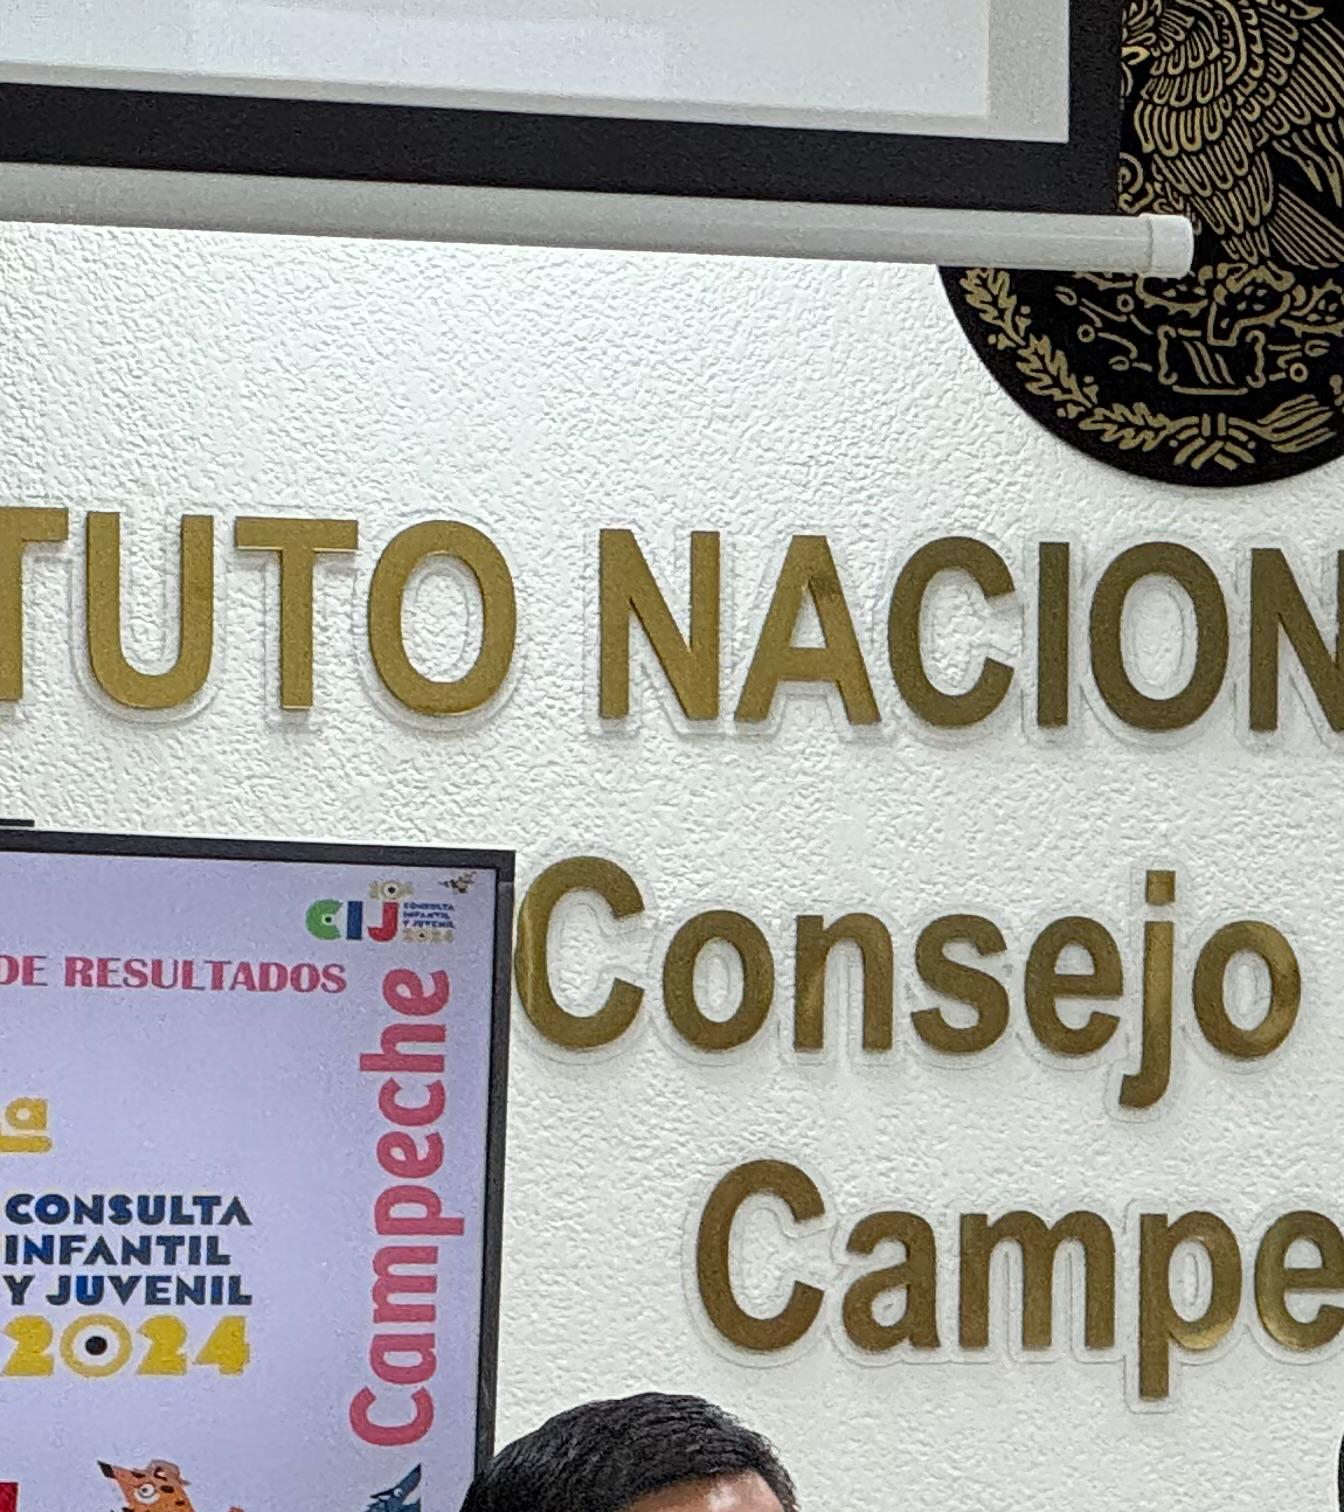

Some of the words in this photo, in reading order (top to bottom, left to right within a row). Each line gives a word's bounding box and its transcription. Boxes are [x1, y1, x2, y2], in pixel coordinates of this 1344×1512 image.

[306, 899, 399, 943] CIJ
[0, 955, 48, 987] DE
[64, 956, 347, 993] RESULTADOS
[514, 855, 1302, 1109] Consejo
[5, 1193, 252, 1225] CONSULTA
[350, 968, 465, 1447] Campeche
[4, 1235, 231, 1266] INFANTIL
[3, 1275, 35, 1306] Y
[46, 1275, 252, 1306] JUVENIL
[1, 1313, 250, 1378] 2024
